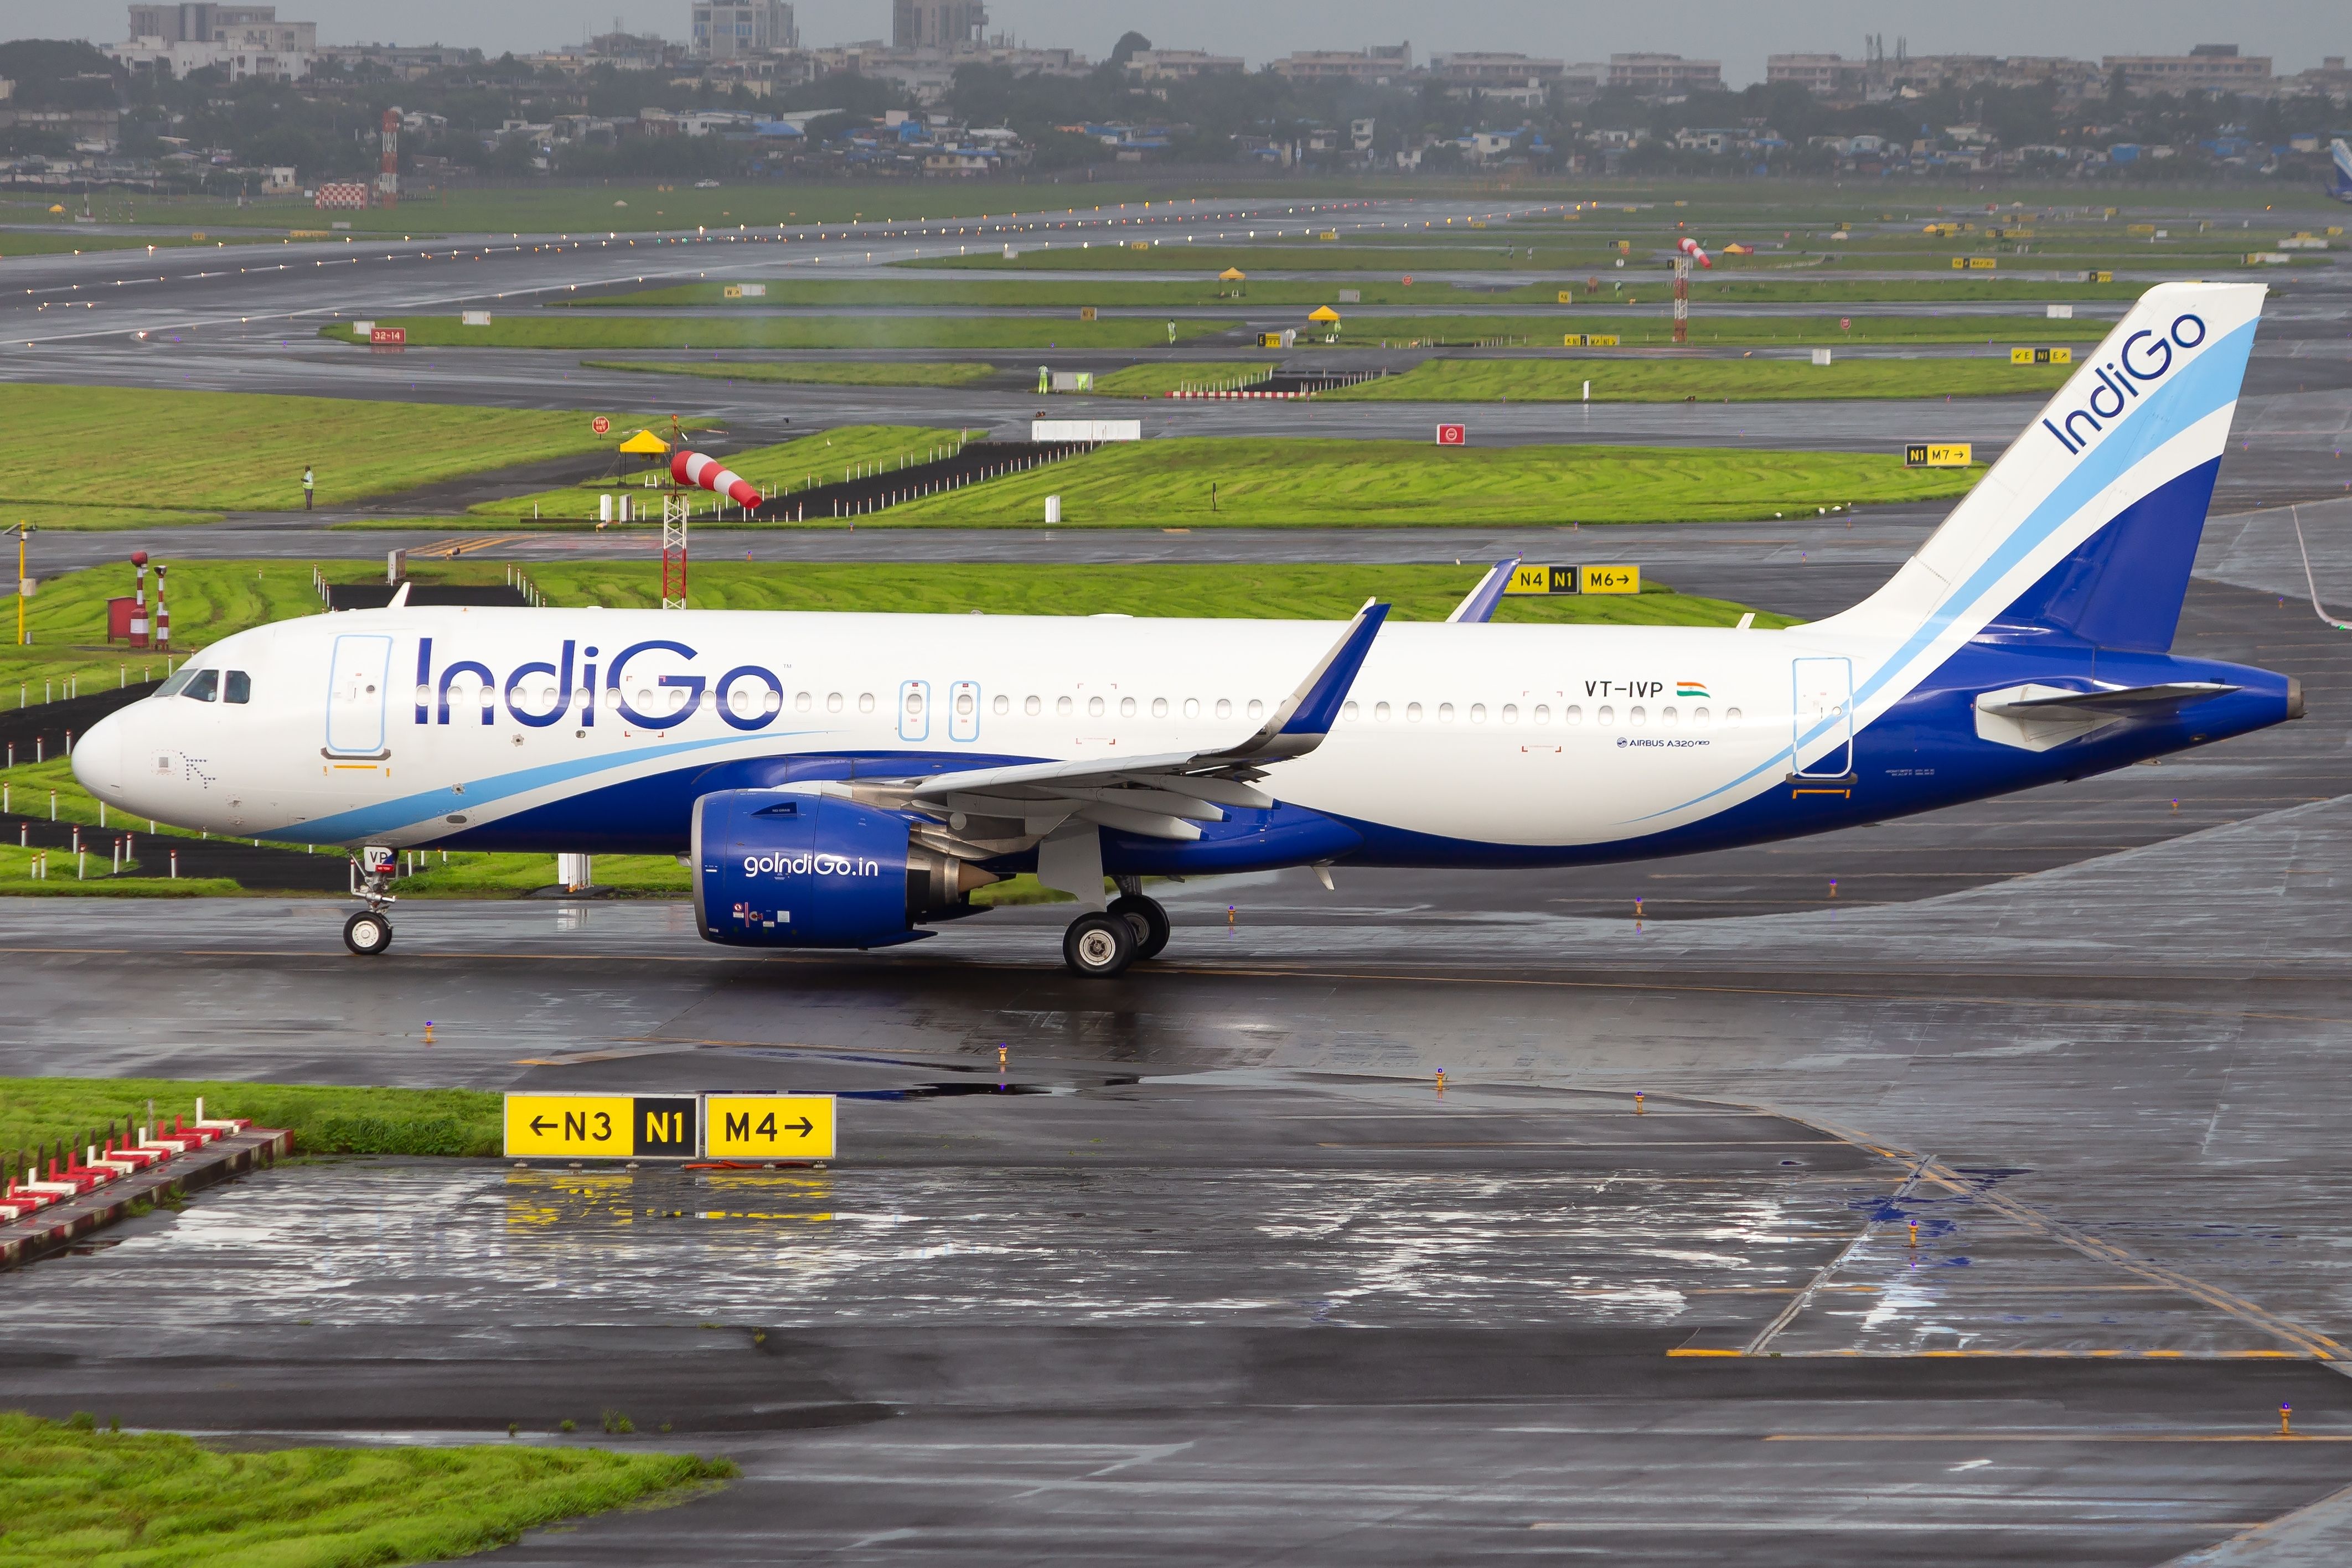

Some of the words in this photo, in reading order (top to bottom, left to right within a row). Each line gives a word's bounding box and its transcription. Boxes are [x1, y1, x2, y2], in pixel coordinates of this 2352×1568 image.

[374, 331, 400, 341] 32-14
[2025, 351, 2030, 360] E
[2037, 351, 2048, 360] N1
[2053, 351, 2059, 359] E
[2042, 313, 2206, 456] IndiGo
[1910, 449, 1924, 462] N1
[1932, 449, 1950, 460] M7
[1521, 572, 1543, 586] N4
[1554, 572, 1572, 587] N1
[1590, 572, 1614, 587] M6
[415, 637, 783, 731] IndiGo
[1585, 680, 1663, 698] VT-IVP
[1629, 739, 1665, 747] AIRBUS
[369, 851, 389, 863] VP
[743, 851, 879, 878] goIndiGo.in
[564, 1111, 612, 1142] N3
[646, 1111, 684, 1143] N1
[725, 1111, 778, 1142] M4
